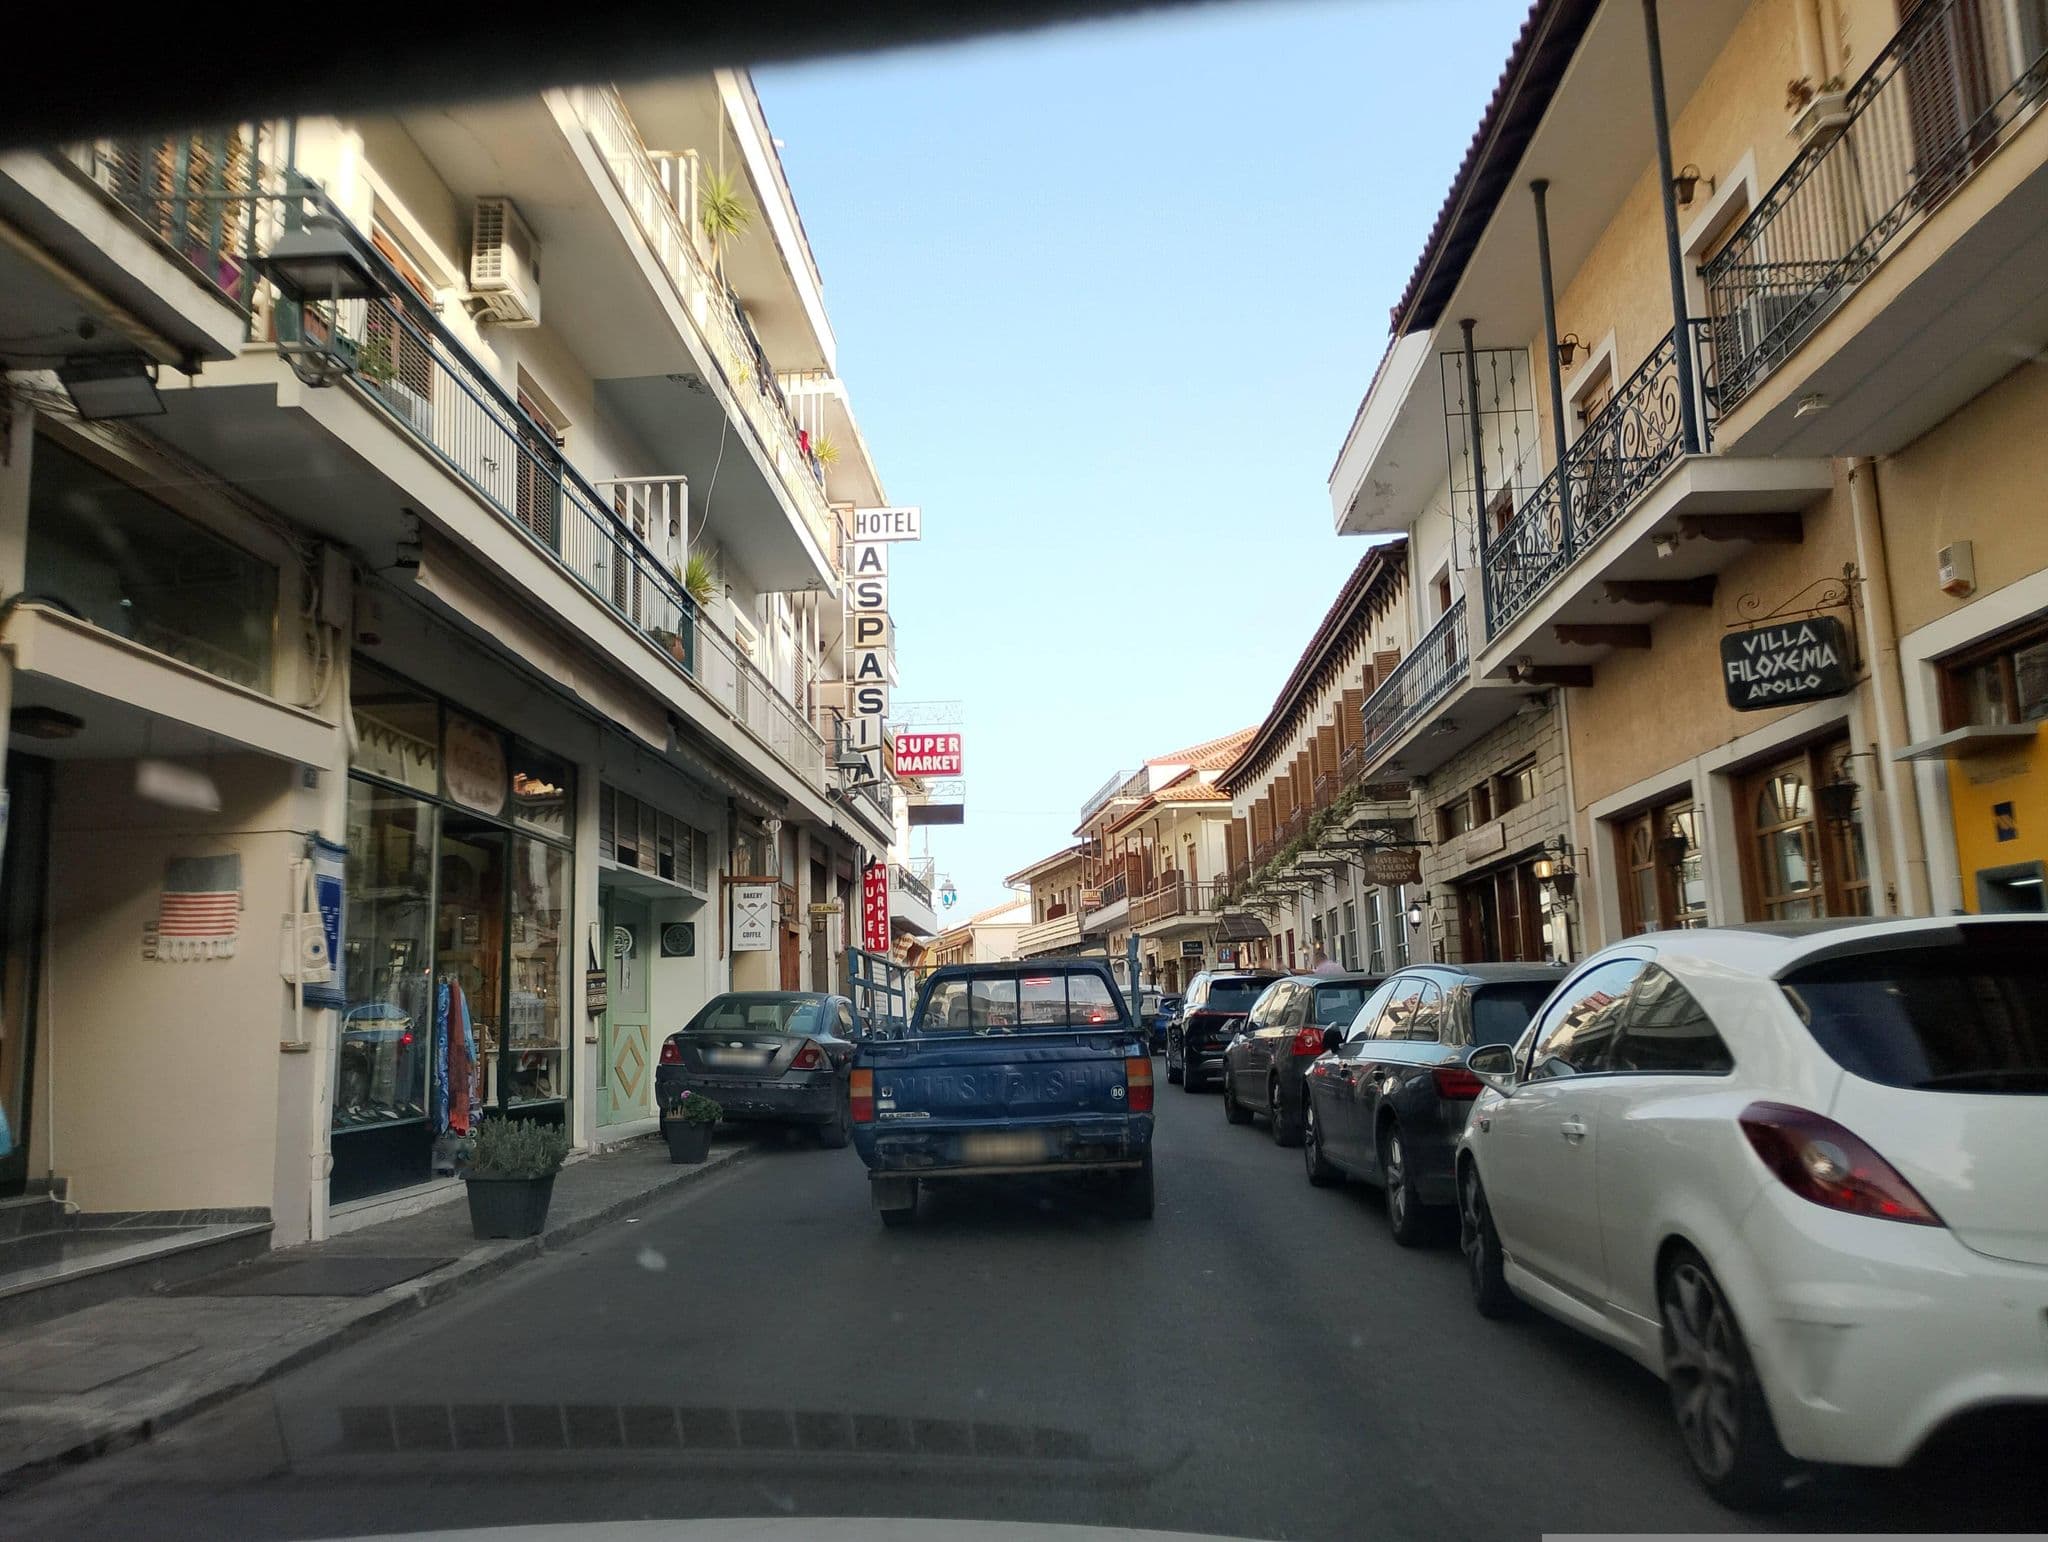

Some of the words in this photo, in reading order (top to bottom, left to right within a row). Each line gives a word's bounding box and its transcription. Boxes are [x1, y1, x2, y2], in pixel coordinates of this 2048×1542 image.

[856, 513, 916, 534] HOTEL
[1742, 624, 1817, 655] VILLA
[853, 546, 884, 783] ASPASIA
[1727, 643, 1838, 683] FILOXENIA
[1747, 673, 1822, 700] APOLLO
[897, 737, 959, 754] SUPER
[897, 755, 960, 771] MARKET
[865, 870, 876, 949] SUPER
[875, 869, 886, 948] MARKET
[895, 1067, 1107, 1104] MITSUBISHI
